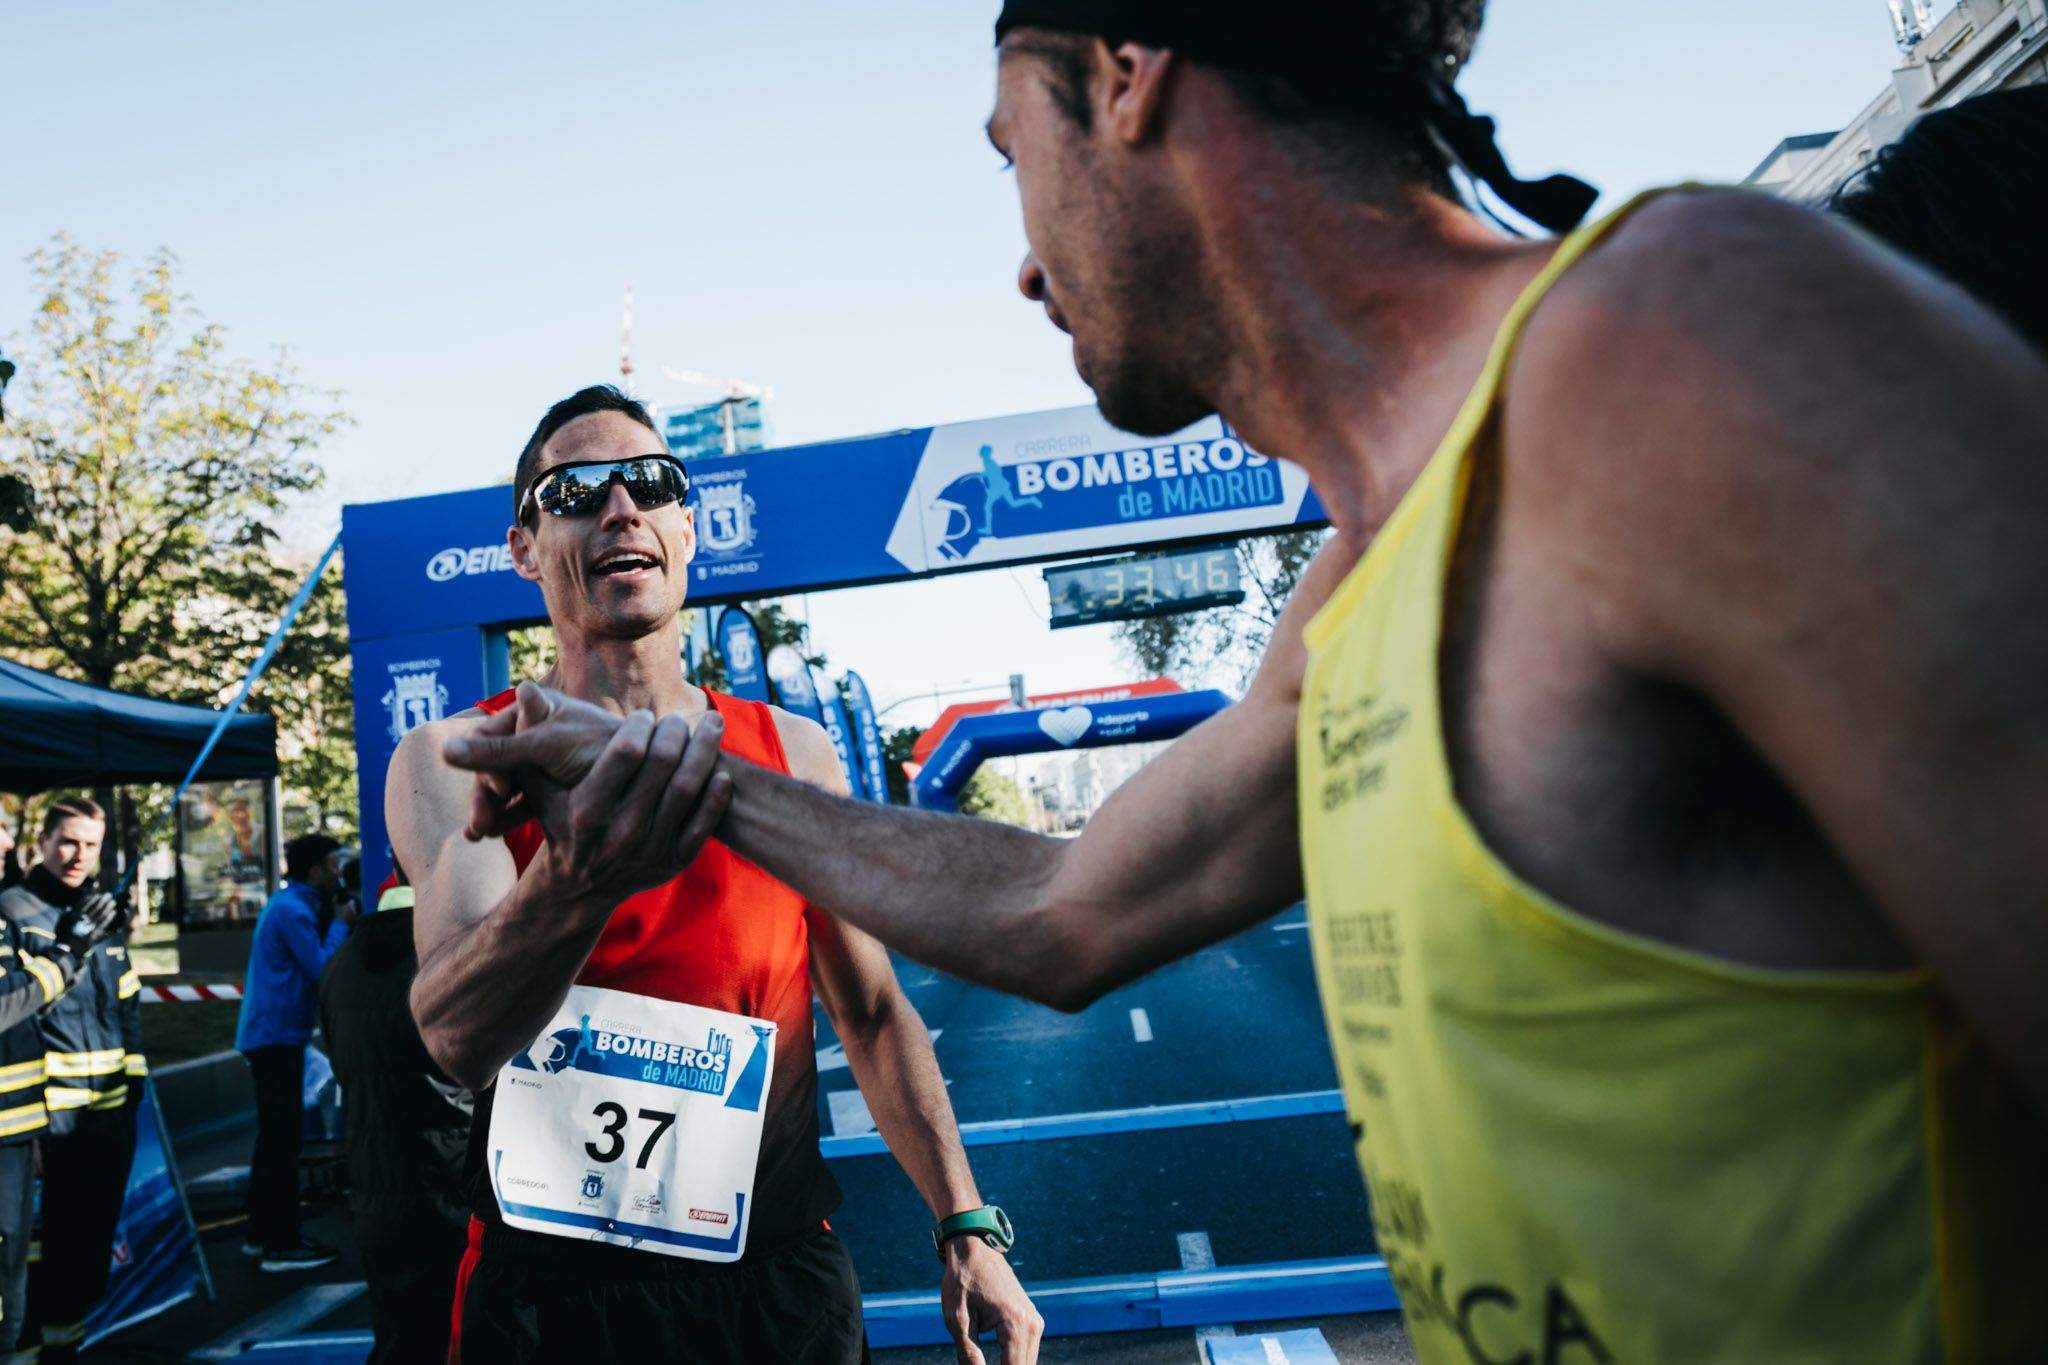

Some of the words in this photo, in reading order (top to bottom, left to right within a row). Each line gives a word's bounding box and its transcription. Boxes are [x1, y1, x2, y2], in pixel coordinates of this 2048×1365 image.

[1014, 434, 1092, 457] CARRERA
[1016, 437, 1269, 496] BOMBEROS
[1118, 483, 1152, 519] de
[1161, 467, 1275, 514] MADRID
[711, 560, 760, 576] MADRID
[596, 1032, 727, 1073] BOMBEROS
[642, 1061, 661, 1082] de
[664, 1065, 725, 1094] MADRID
[584, 1101, 677, 1170] 37
